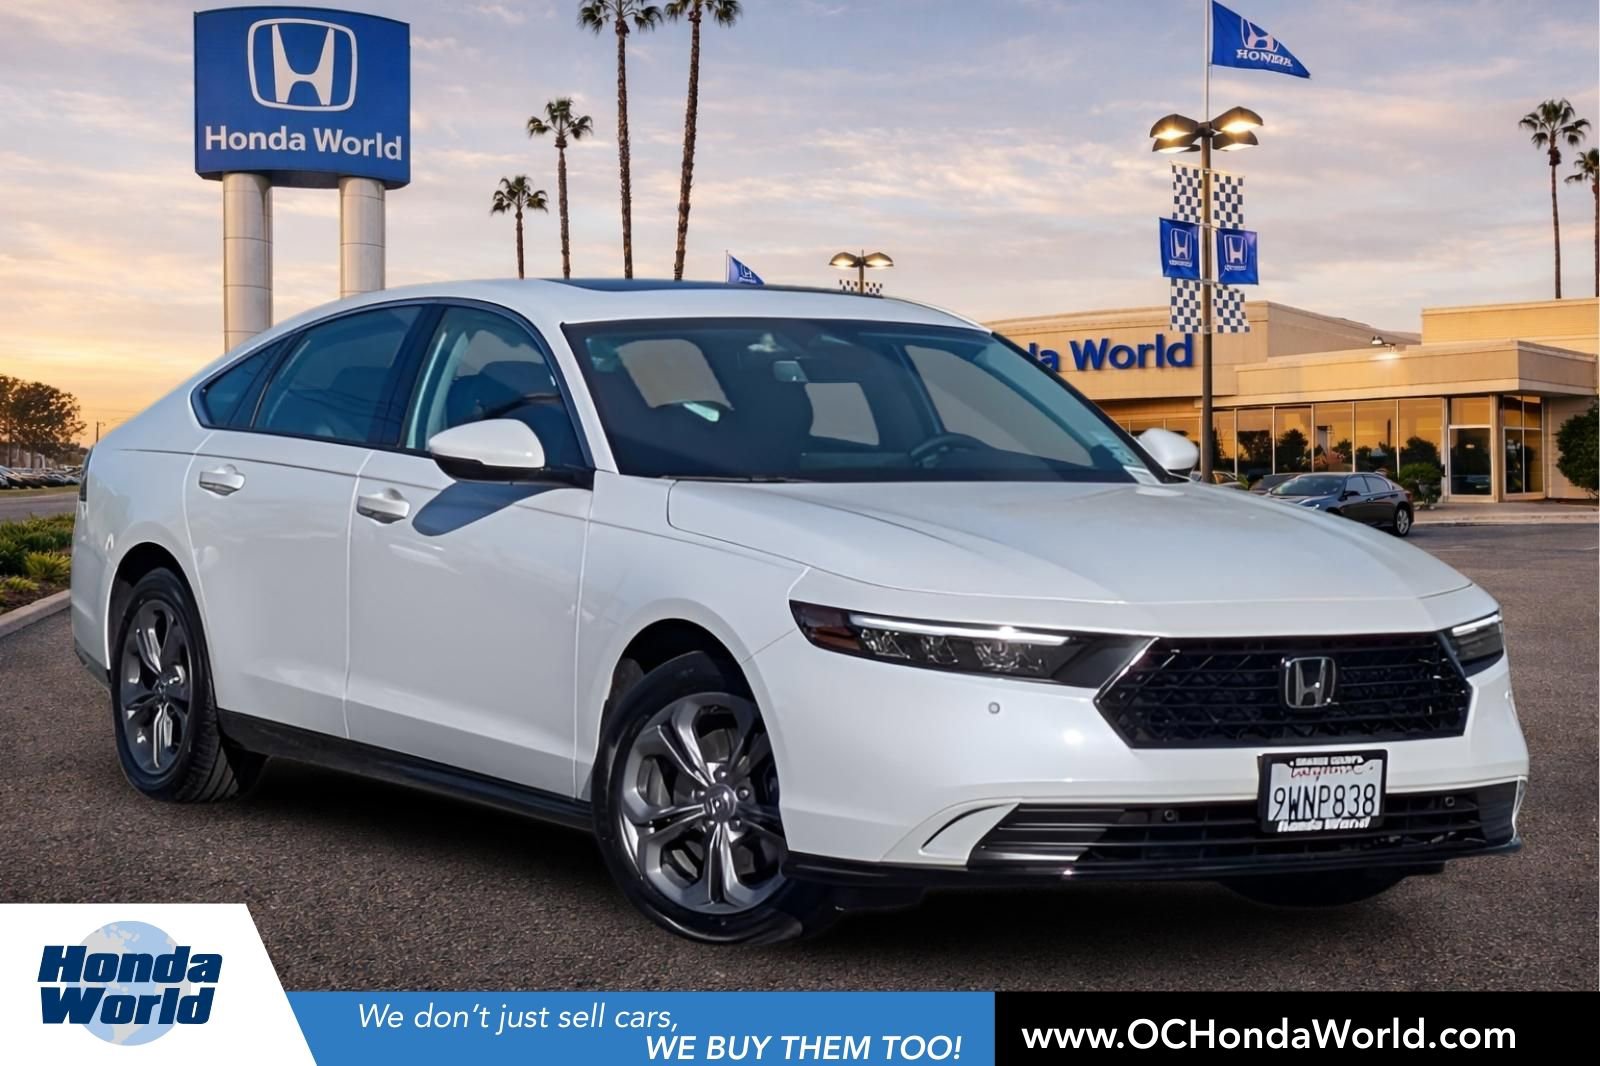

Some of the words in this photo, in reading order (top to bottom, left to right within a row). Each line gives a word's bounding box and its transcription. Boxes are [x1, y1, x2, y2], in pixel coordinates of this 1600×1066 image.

[205, 125, 306, 151] Honda
[313, 127, 402, 160] World
[1069, 333, 1194, 371] World
[1273, 783, 1376, 822] 9WNP838
